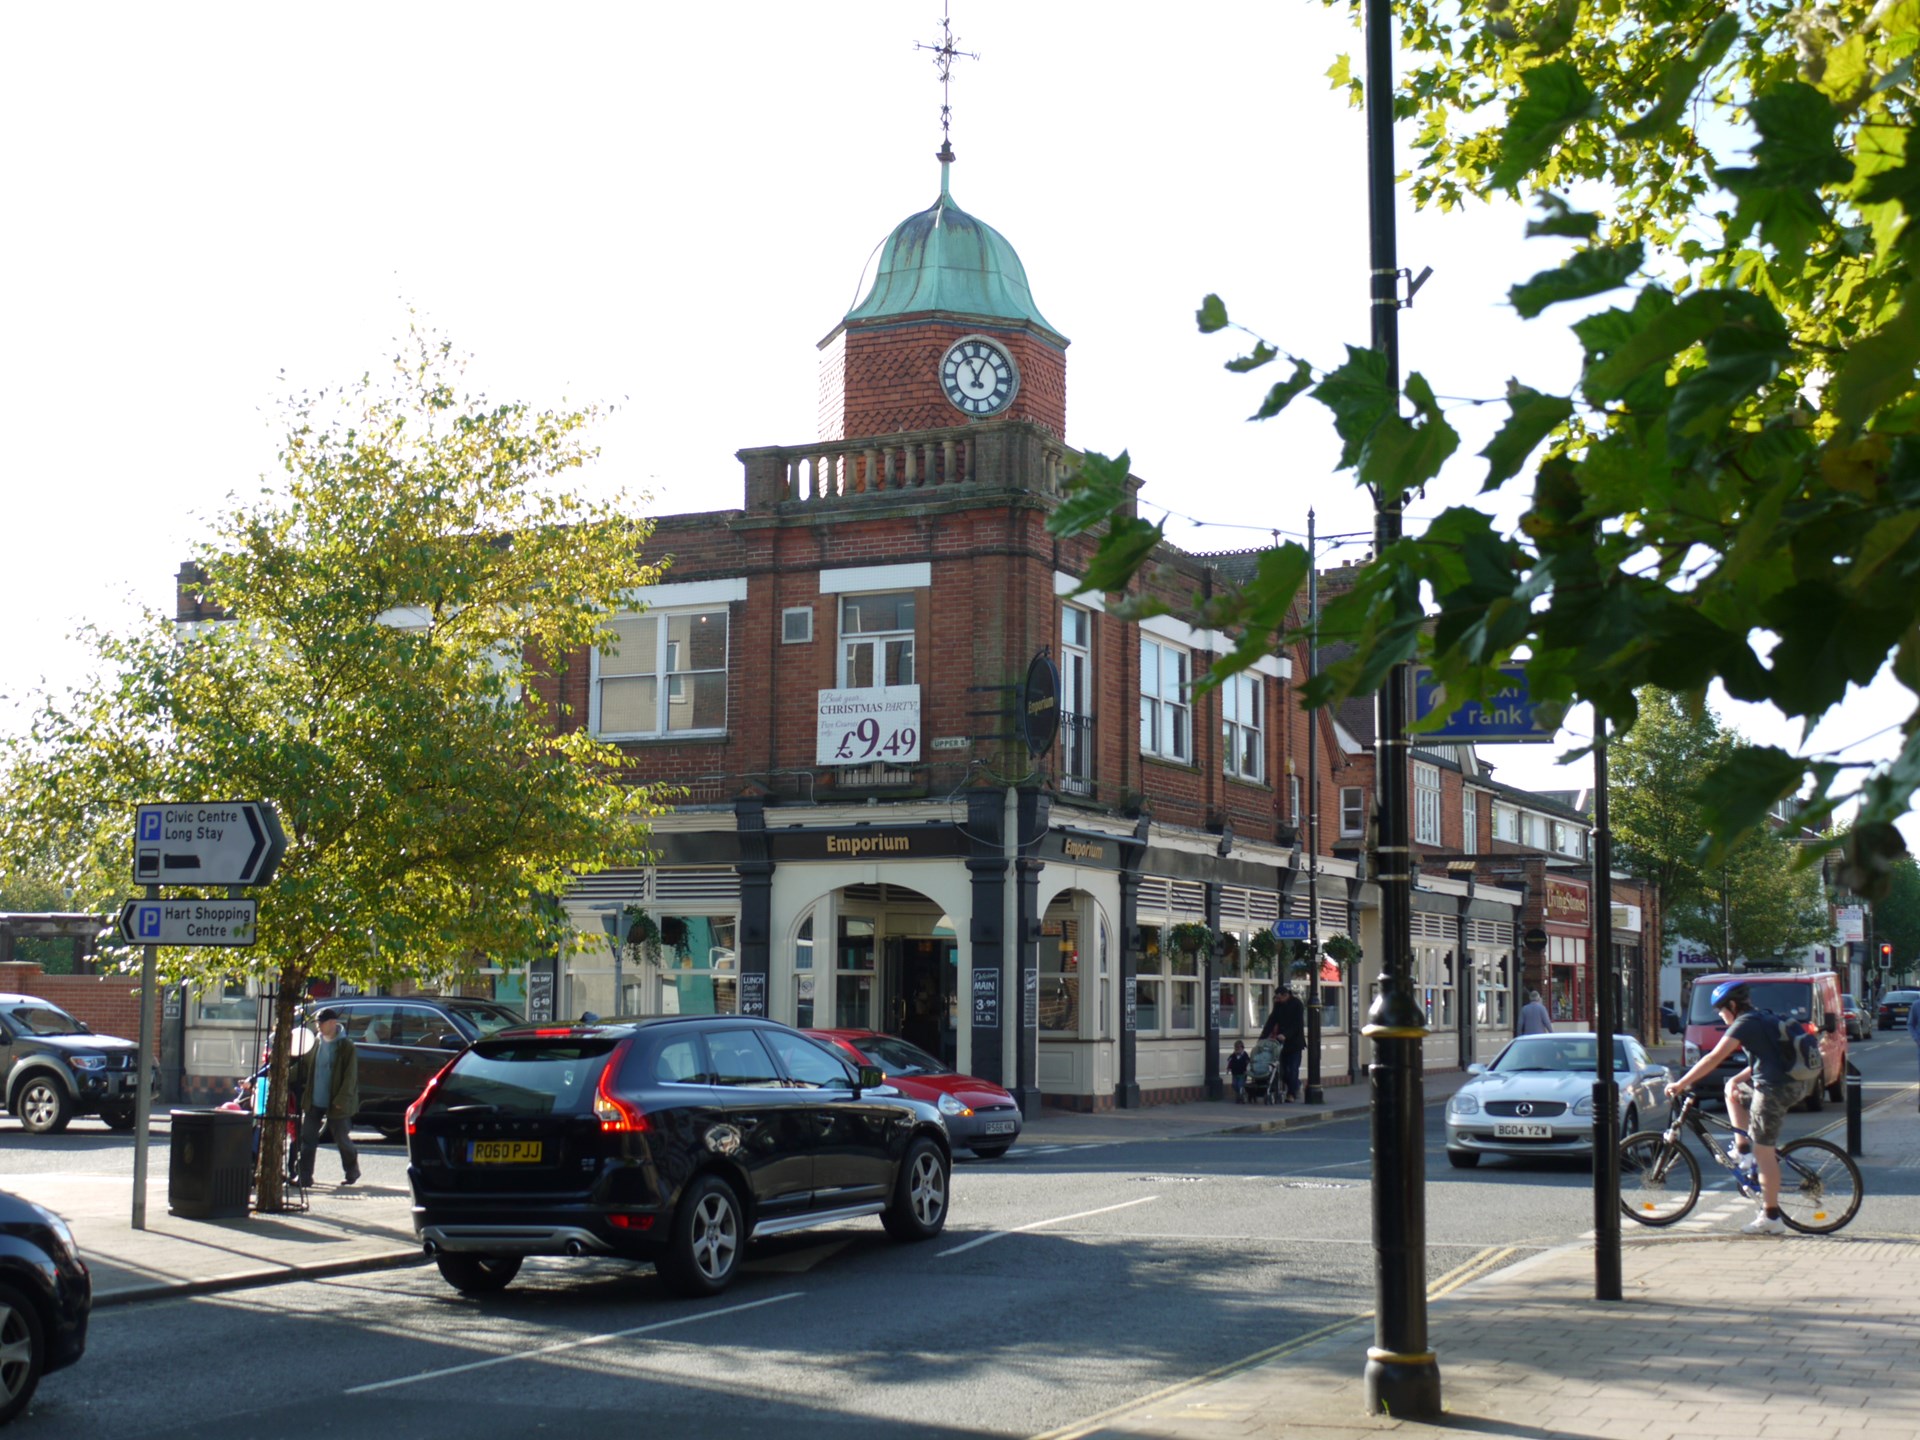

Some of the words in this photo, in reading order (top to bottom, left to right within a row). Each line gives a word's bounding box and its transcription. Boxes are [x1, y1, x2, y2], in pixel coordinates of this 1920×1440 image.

[820, 703, 883, 715] CHRISTMAS
[1028, 696, 1054, 716] Emporium
[834, 718, 917, 759] £9.49
[934, 739, 959, 747] UPPER
[165, 810, 194, 823] Civic
[197, 809, 238, 823] Centre
[165, 828, 192, 842] Long
[196, 826, 224, 841] Stay
[826, 832, 910, 857] Emporium
[1064, 838, 1103, 860] Emporium
[165, 907, 191, 920] Hart
[195, 906, 250, 922] Shopping
[186, 923, 227, 936] Centre
[743, 976, 765, 985] LUNCH
[973, 981, 995, 990] MAIN
[460, 1122, 540, 1132] VOLVO
[1498, 1125, 1525, 1136] BG04
[475, 1142, 511, 1159] RO60
[512, 1142, 540, 1159] PJJ
